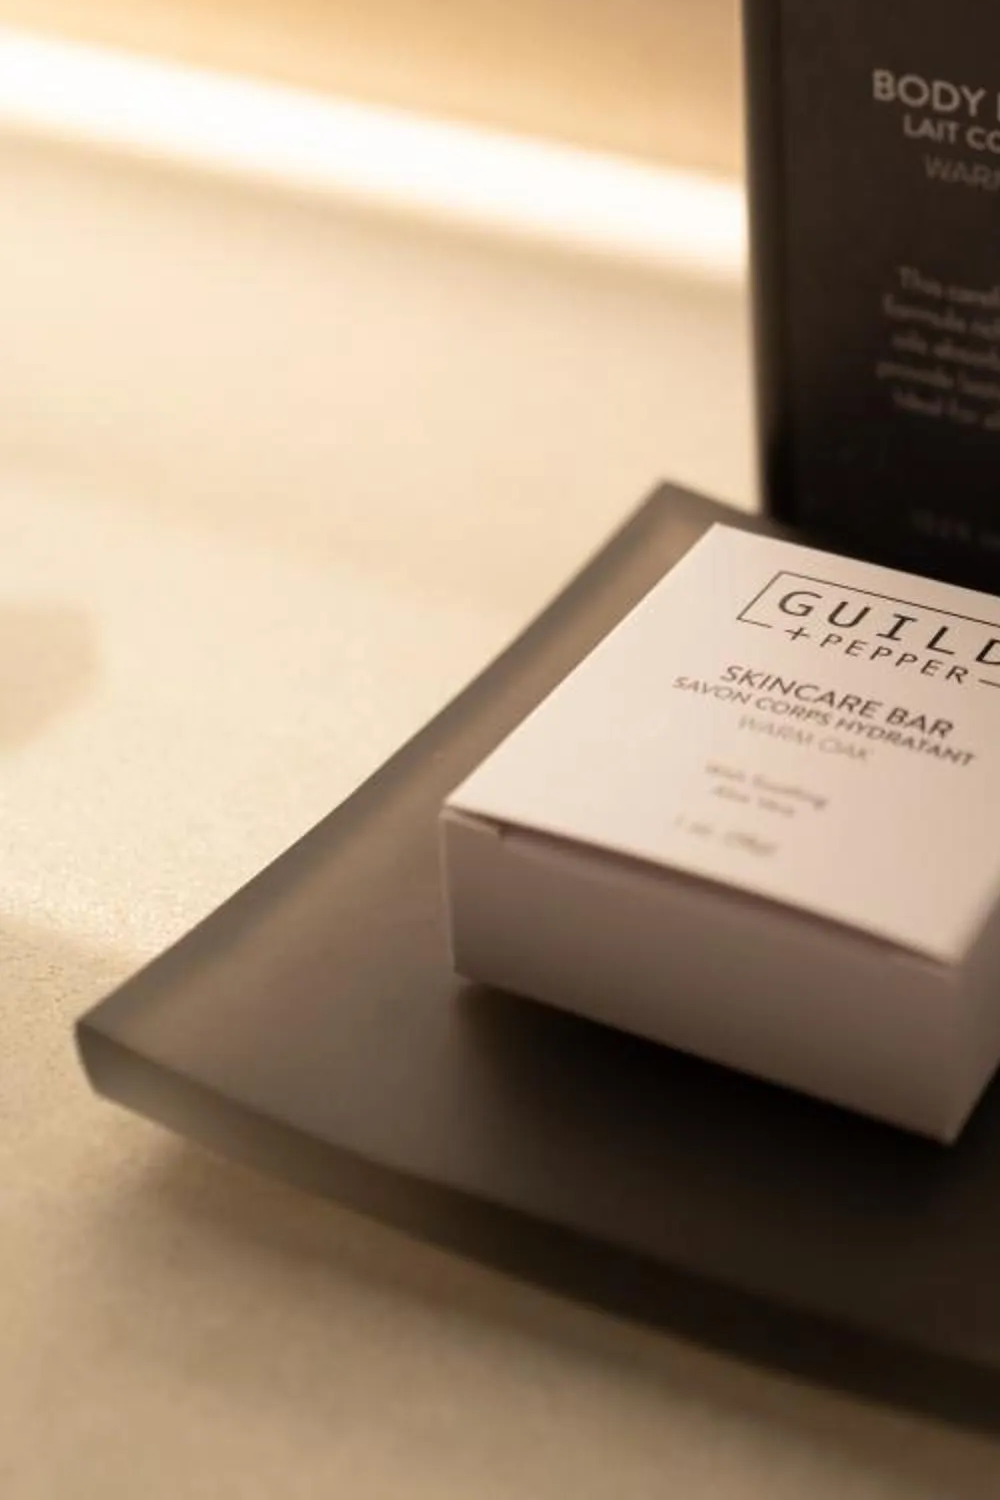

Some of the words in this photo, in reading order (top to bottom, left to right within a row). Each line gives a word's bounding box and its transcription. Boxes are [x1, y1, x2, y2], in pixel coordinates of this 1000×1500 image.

[872, 68, 986, 117] BODY
[903, 113, 960, 145] LAIT
[672, 675, 752, 706] SAVON
[755, 695, 831, 727] CORPS
[835, 715, 976, 768] HYDRATANT
[719, 664, 884, 719] SKINCARE
[885, 705, 954, 740] BAR
